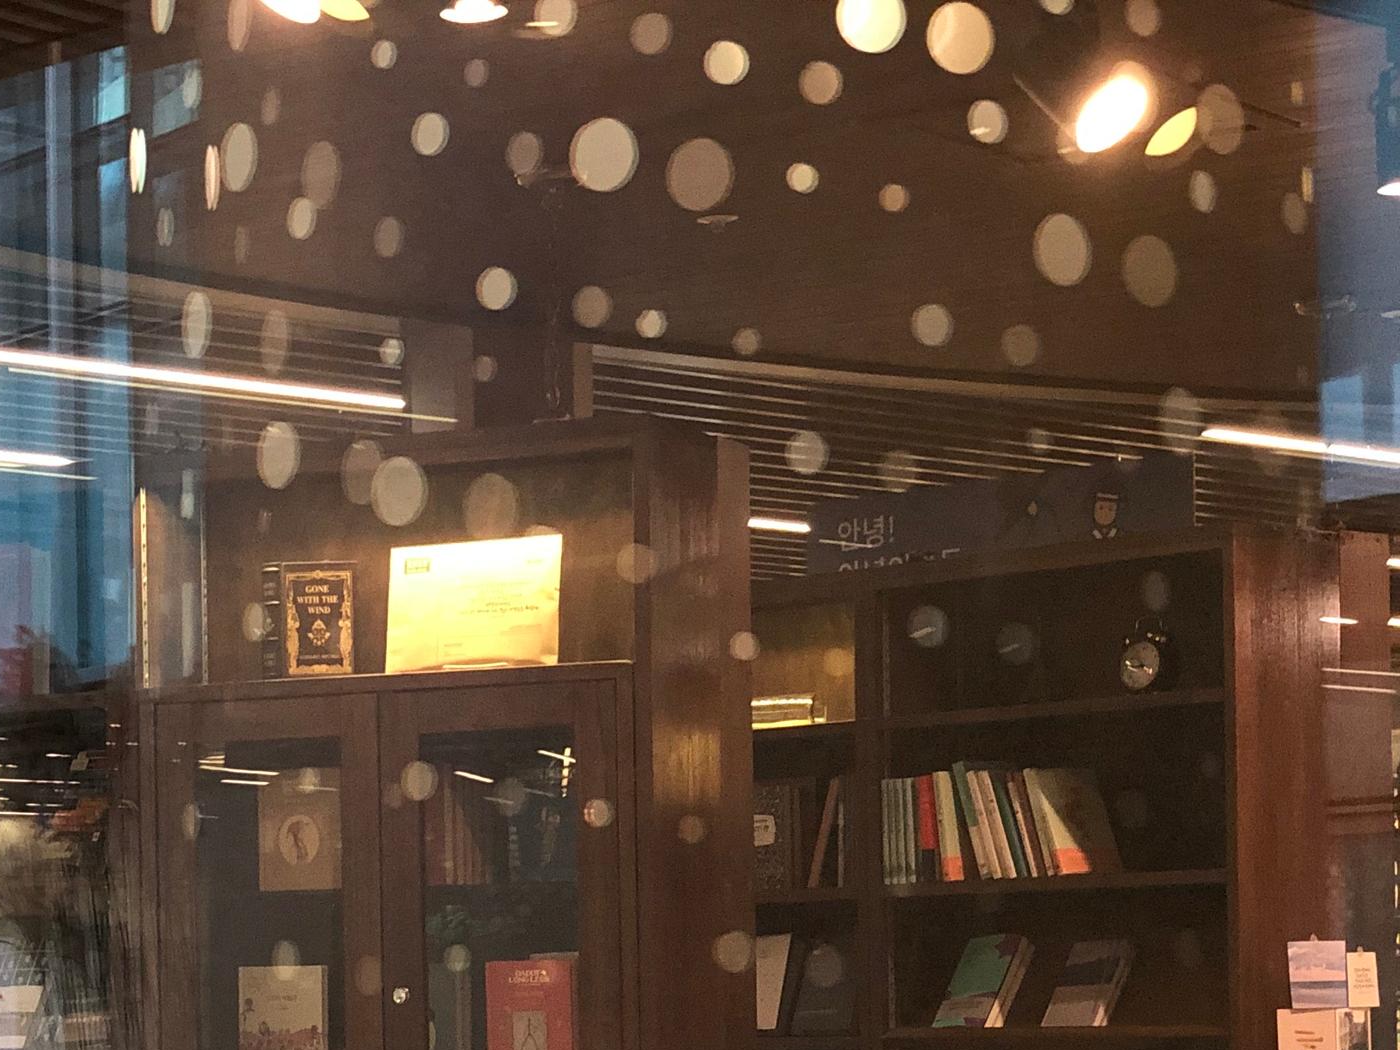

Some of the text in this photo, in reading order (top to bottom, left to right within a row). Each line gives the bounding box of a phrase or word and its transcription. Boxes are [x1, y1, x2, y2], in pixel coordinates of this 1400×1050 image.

[838, 514, 895, 552] 안녕!
[305, 584, 330, 594] GONE
[297, 595, 339, 604] WITH THE
[307, 606, 331, 615] WIND
